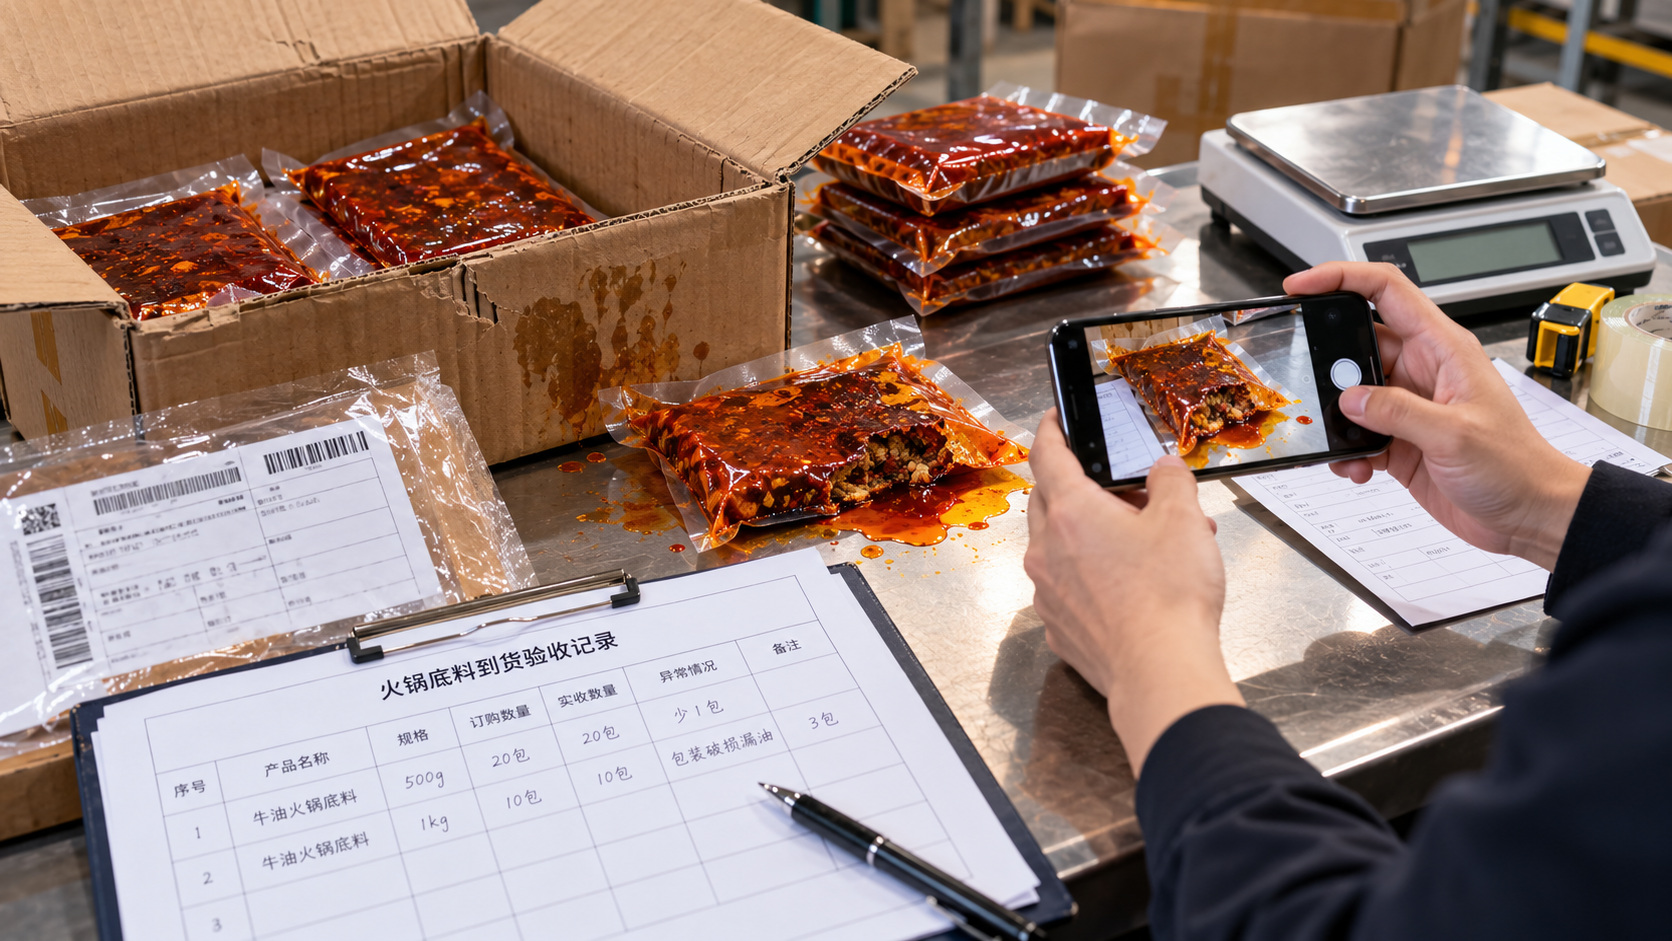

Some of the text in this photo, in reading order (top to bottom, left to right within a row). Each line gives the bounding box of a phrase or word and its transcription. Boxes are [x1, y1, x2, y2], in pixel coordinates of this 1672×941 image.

[380, 631, 619, 700] 火锅底料到货验收记录
[173, 638, 802, 799] 序号 产品名称 规格 订购数量 实收数量 异常情况 备注
[252, 789, 358, 827] 牛油火锅底料
[404, 769, 445, 790] 500g
[491, 747, 530, 768] 20包
[582, 725, 620, 745] 20包
[262, 711, 839, 871] 牛油火锅底料 1kg 10包 10包 包装破损漏油 3包
[194, 826, 202, 840] 1
[202, 871, 213, 885] 2
[211, 917, 222, 933] 3
